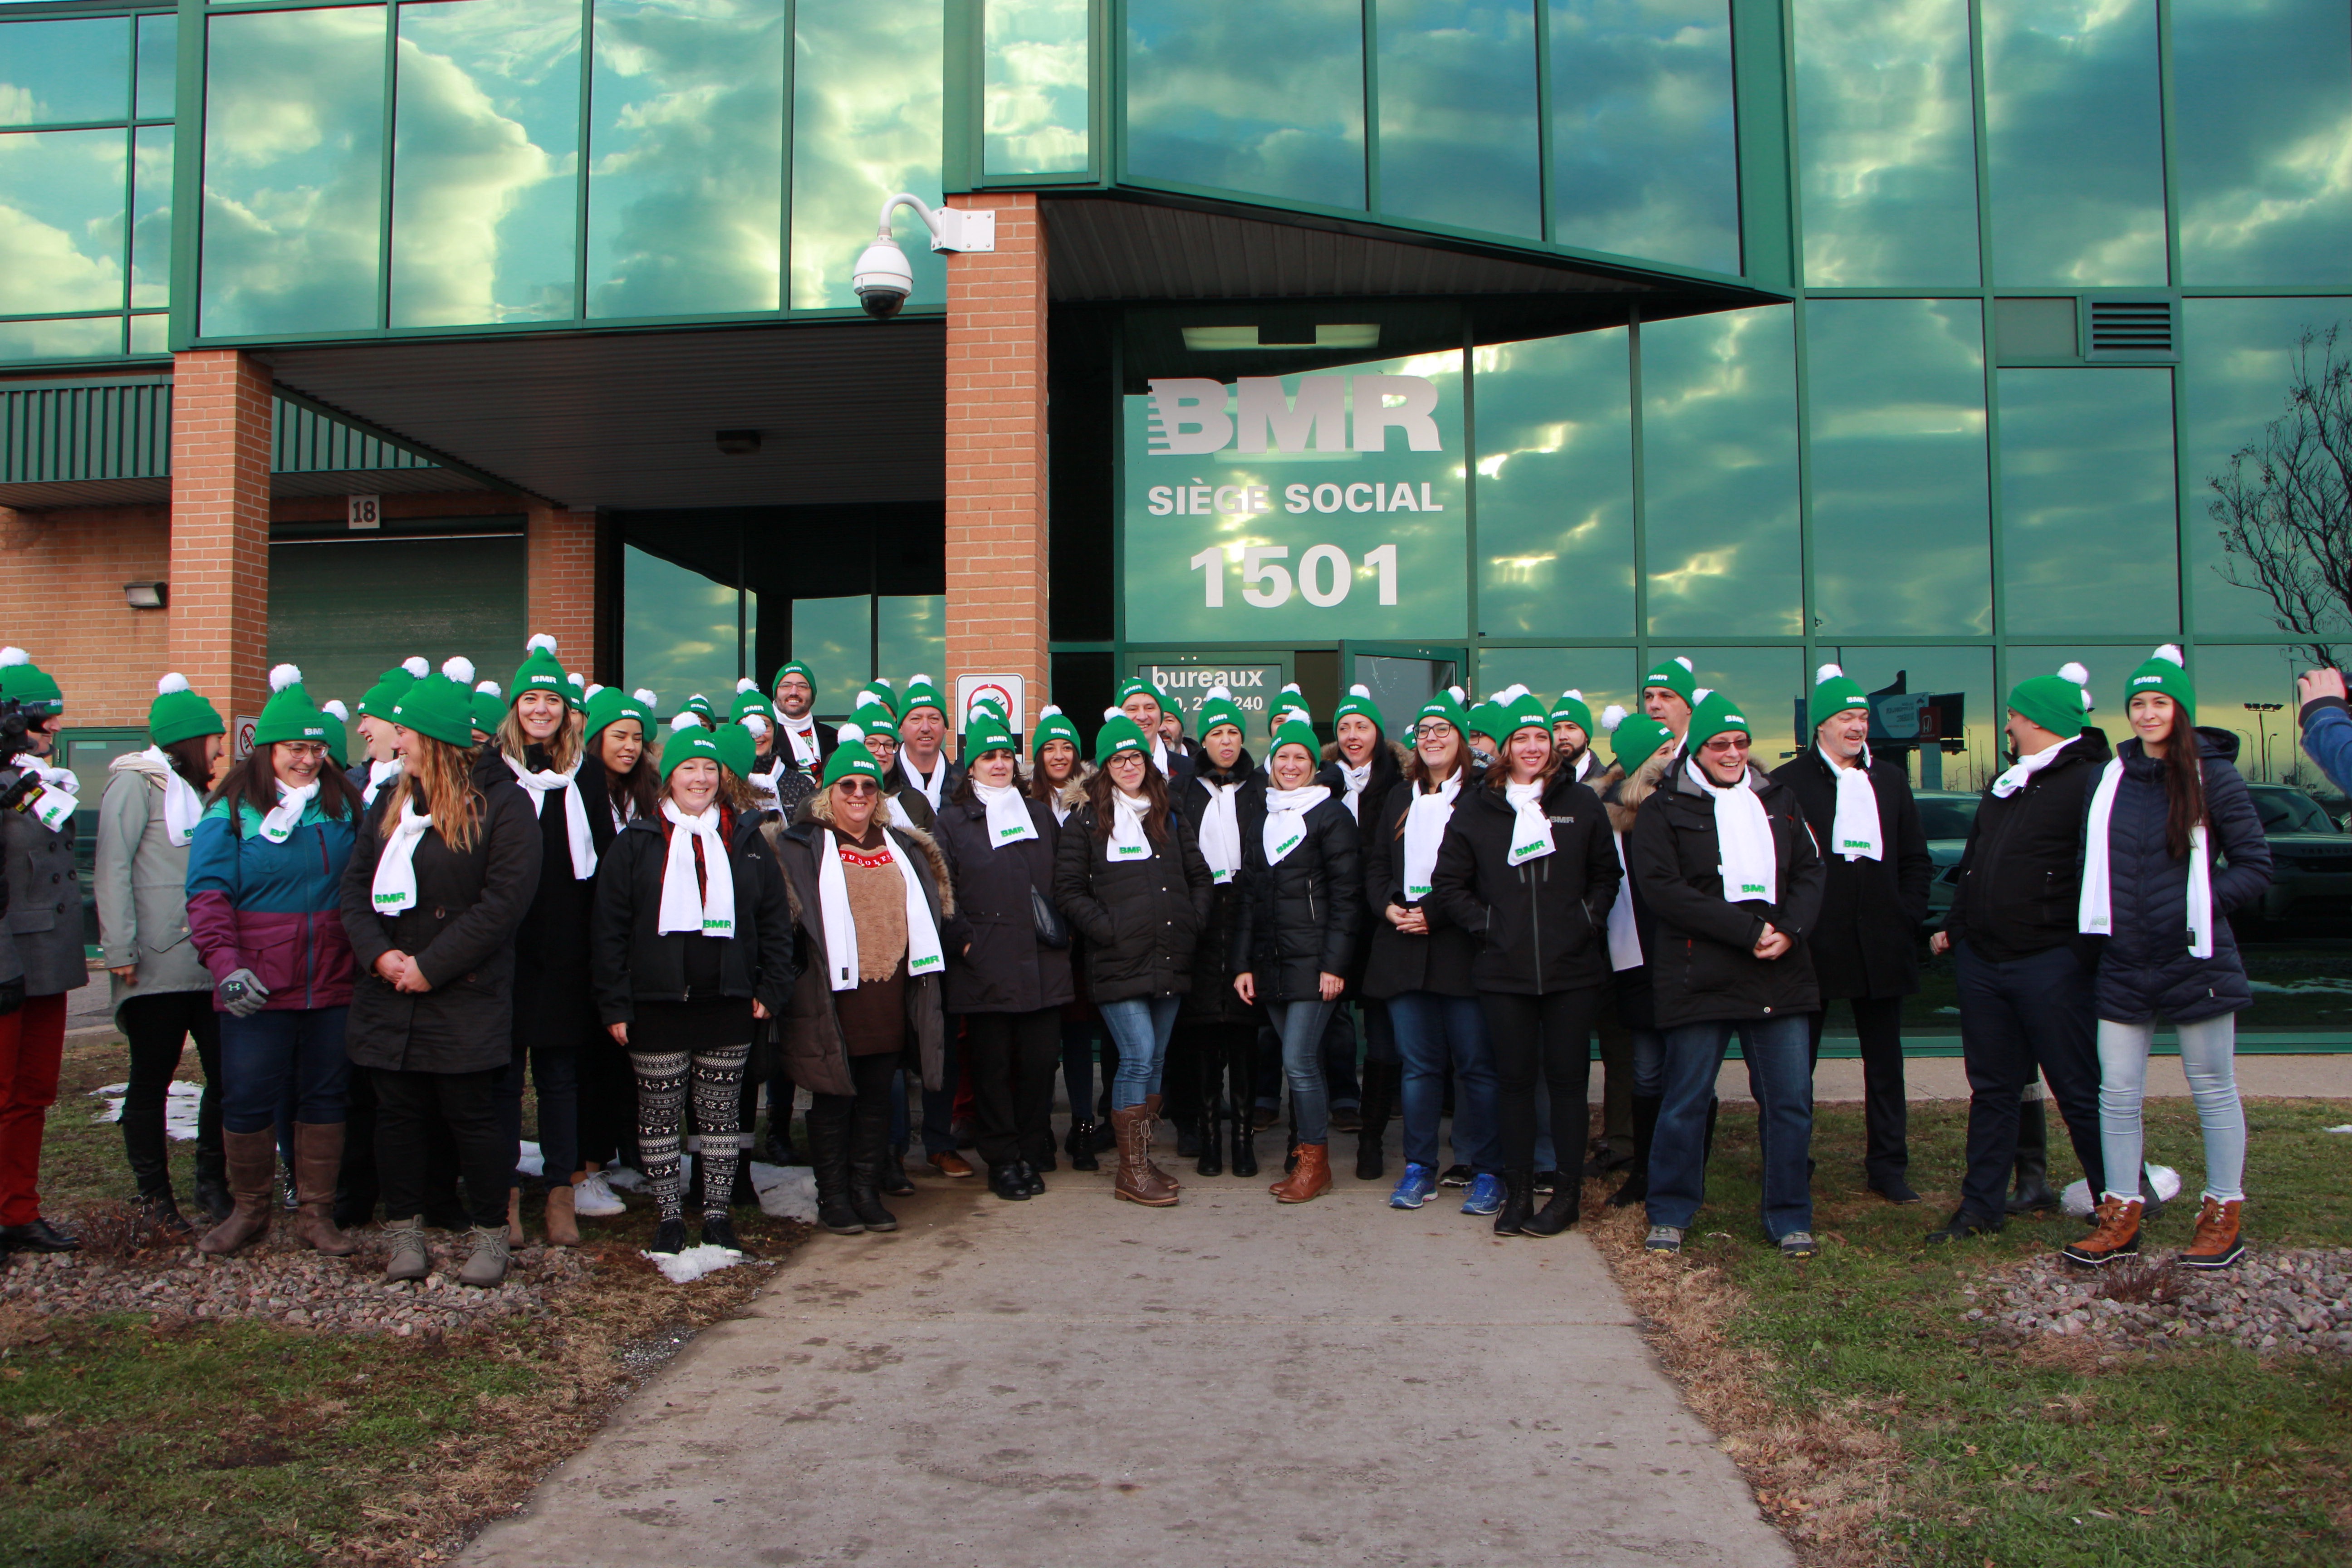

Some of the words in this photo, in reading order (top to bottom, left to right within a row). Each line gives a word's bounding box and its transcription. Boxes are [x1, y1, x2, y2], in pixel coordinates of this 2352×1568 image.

[1148, 375, 1443, 455] BMR
[1148, 478, 1269, 515] SIÈGE
[1285, 483, 1443, 514] SOCIAL
[353, 500, 376, 523] 18
[1191, 544, 1397, 608] 1501
[531, 675, 557, 684] BMR
[1152, 666, 1264, 688] bureaux
[2133, 676, 2162, 686] BMR
[1123, 685, 1142, 695] BMR
[911, 696, 931, 704] BMR
[1233, 696, 1263, 711] 240
[1338, 705, 1357, 714] BMR
[1551, 710, 1569, 719] BMR
[1208, 714, 1227, 724] BMR
[1725, 715, 1745, 725] BMR
[872, 720, 893, 729] BMR
[1050, 727, 1070, 736] BMR
[694, 740, 716, 750] BMR
[1116, 739, 1137, 749] BMR
[853, 761, 875, 770] BMR
[1001, 826, 1024, 837] BMR
[1276, 835, 1299, 853] BMR
[1515, 840, 1546, 857] BMR
[1844, 840, 1871, 850] BMR
[1213, 869, 1226, 878] MR
[1742, 884, 1766, 893] BMR
[374, 892, 405, 903] BMR
[703, 920, 731, 928] BMR
[911, 955, 940, 968] BMR
